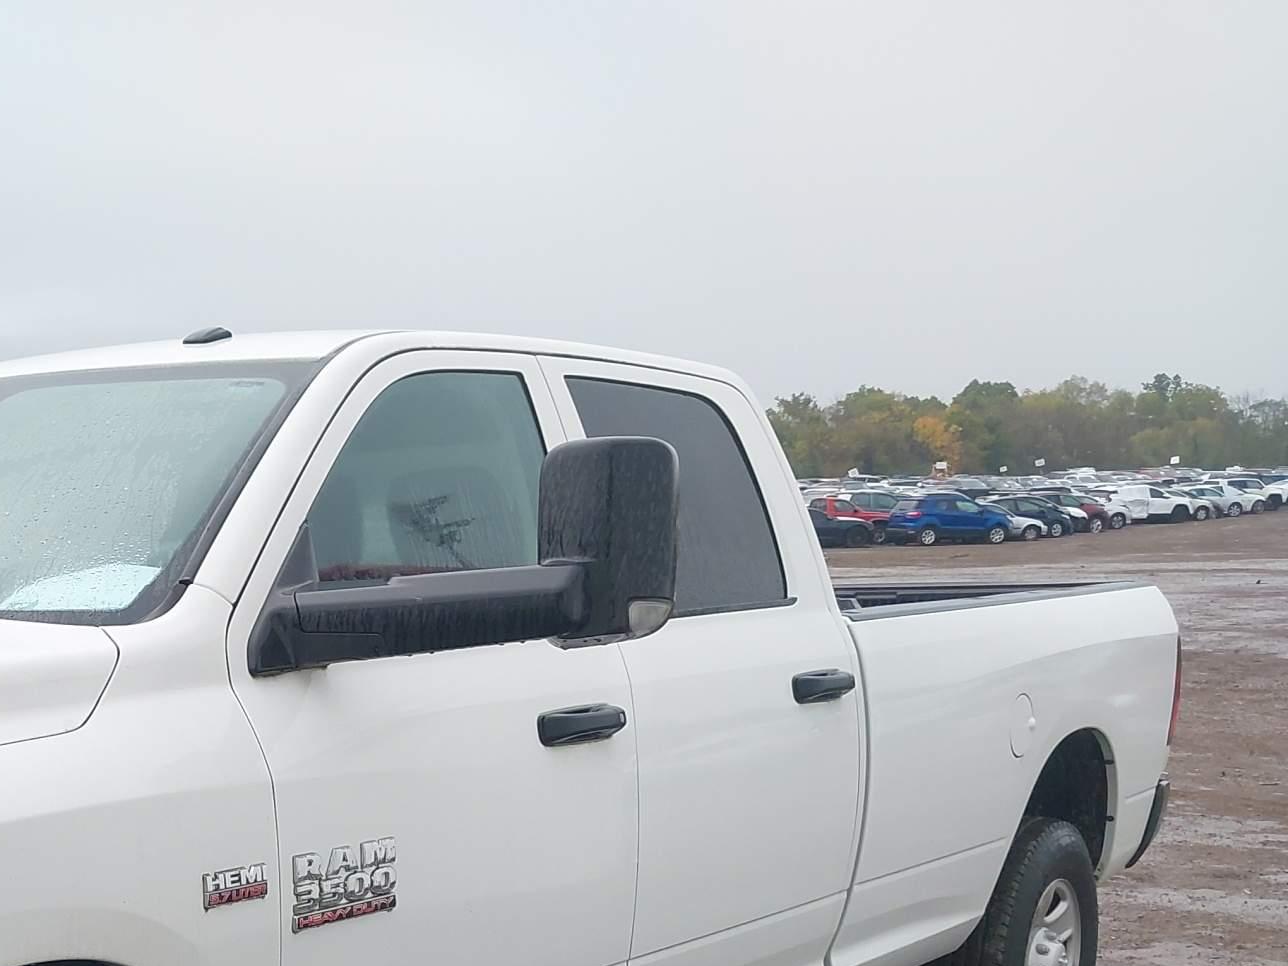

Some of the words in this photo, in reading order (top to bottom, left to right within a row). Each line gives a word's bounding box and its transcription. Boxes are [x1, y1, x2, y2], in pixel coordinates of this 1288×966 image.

[293, 836, 396, 883] RAM
[293, 865, 397, 915] 3500
[298, 906, 352, 928] HEAVY
[353, 897, 394, 916] DUTY
